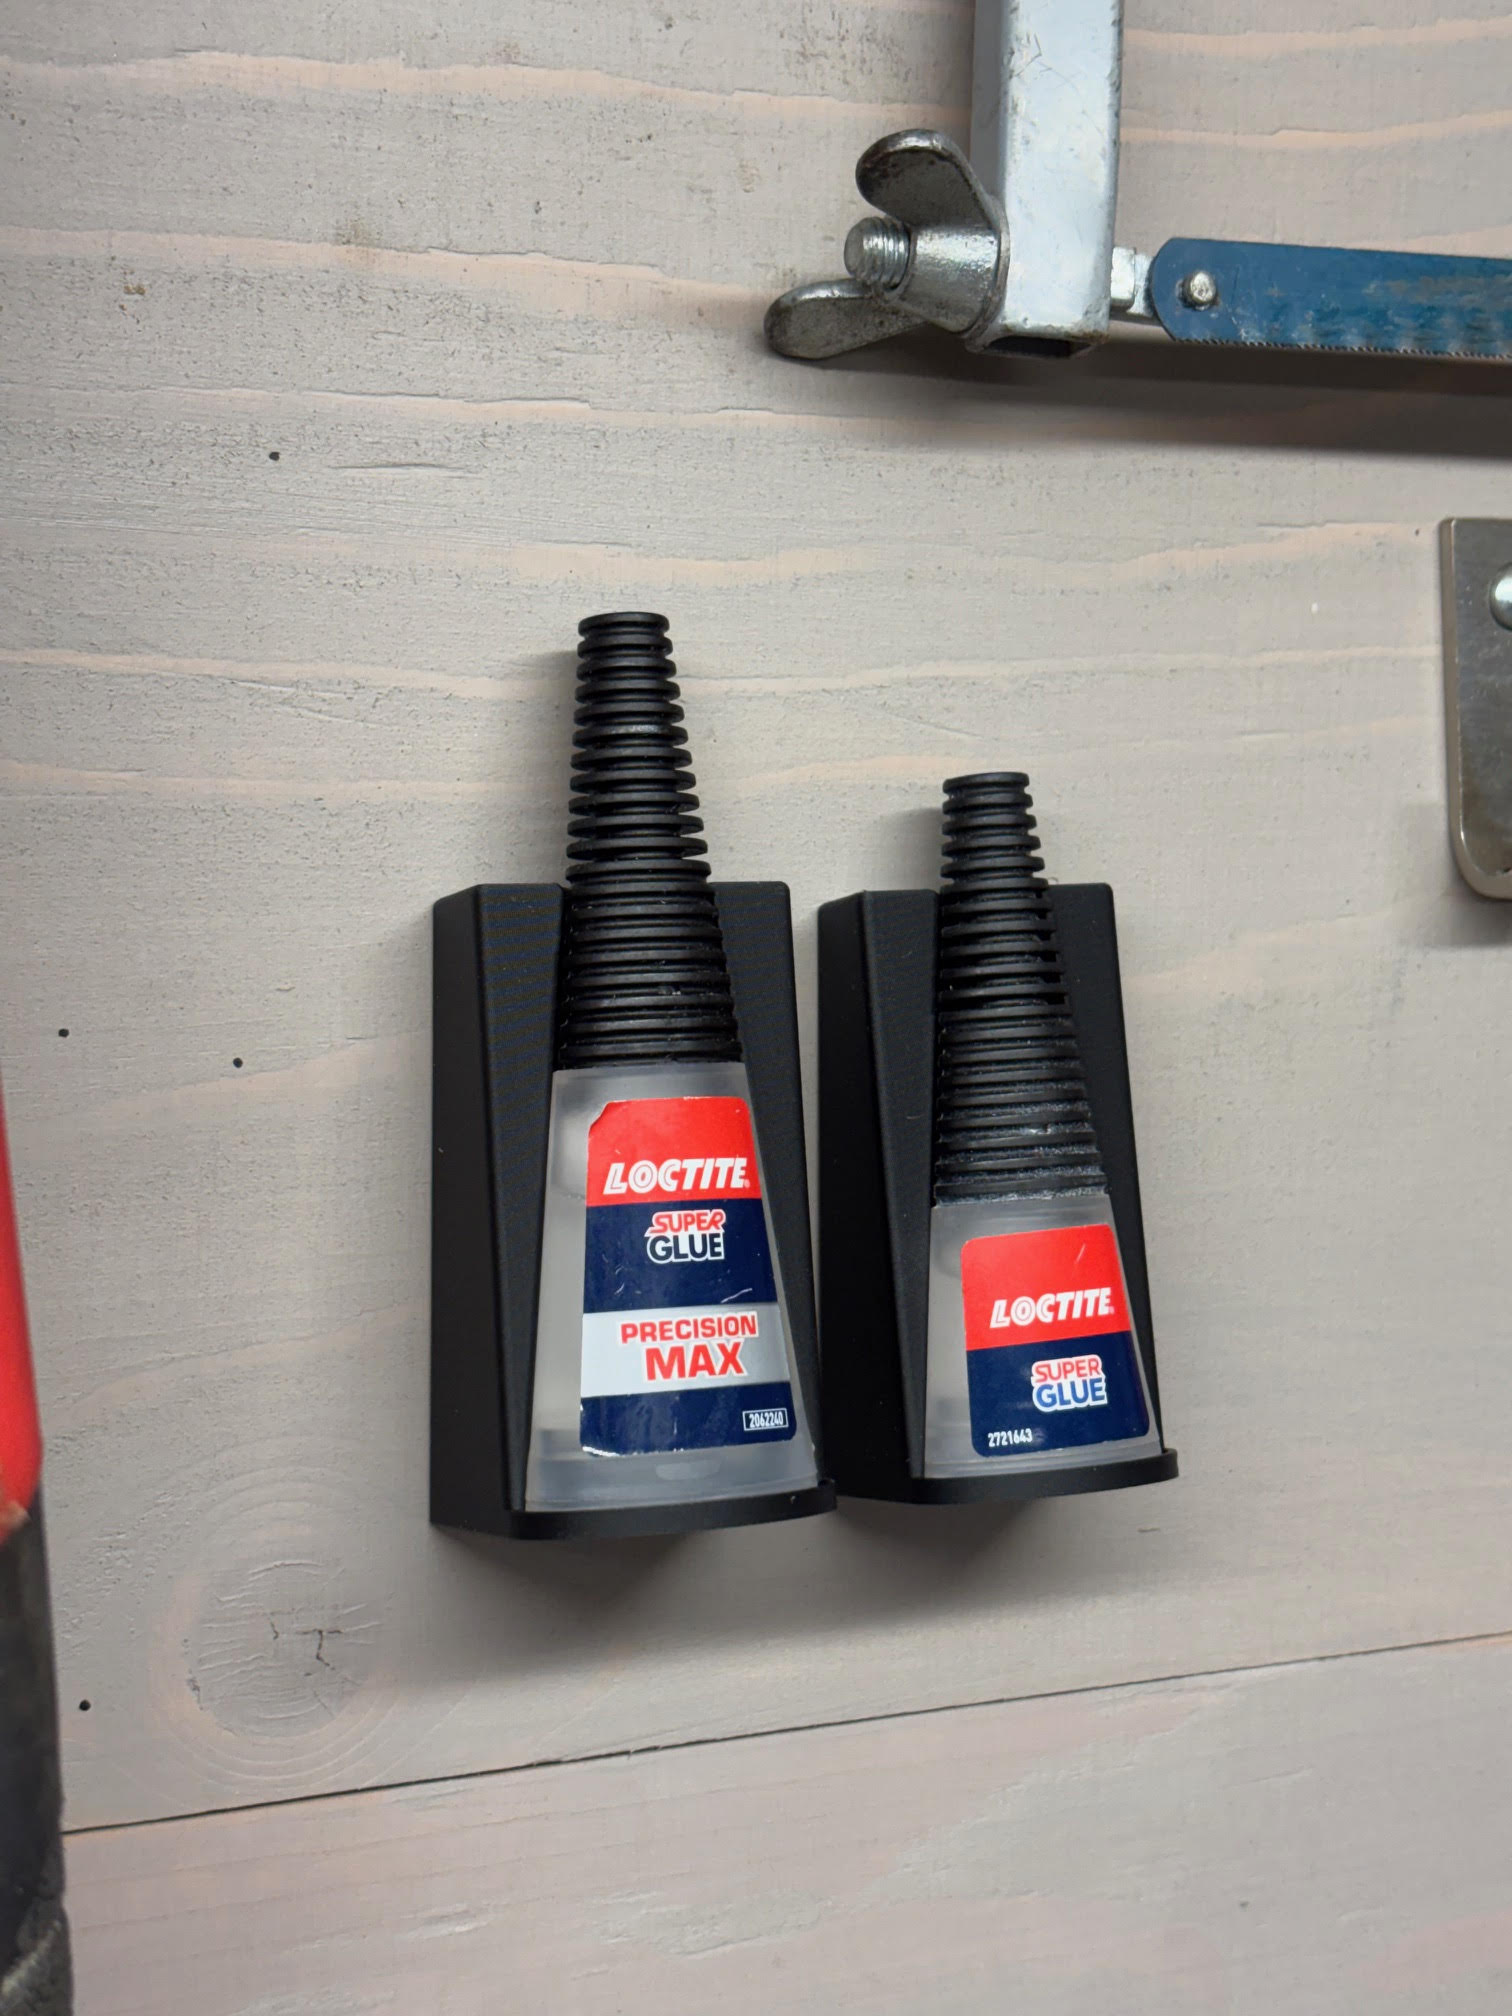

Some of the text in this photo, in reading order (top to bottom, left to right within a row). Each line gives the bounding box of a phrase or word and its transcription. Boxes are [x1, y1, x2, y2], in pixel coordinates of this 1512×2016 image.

[603, 1157, 747, 1194] LOCTITE
[650, 1210, 725, 1233] SUPER
[649, 1232, 723, 1261] GLUE
[990, 1287, 1111, 1328] LOCTITE
[621, 1314, 757, 1343] PRECISION
[646, 1342, 745, 1380] MAX
[1034, 1357, 1100, 1382] SUPER
[1036, 1379, 1106, 1407] GLUE
[749, 1412, 784, 1428] 2062240
[988, 1428, 1032, 1447] 2721643
